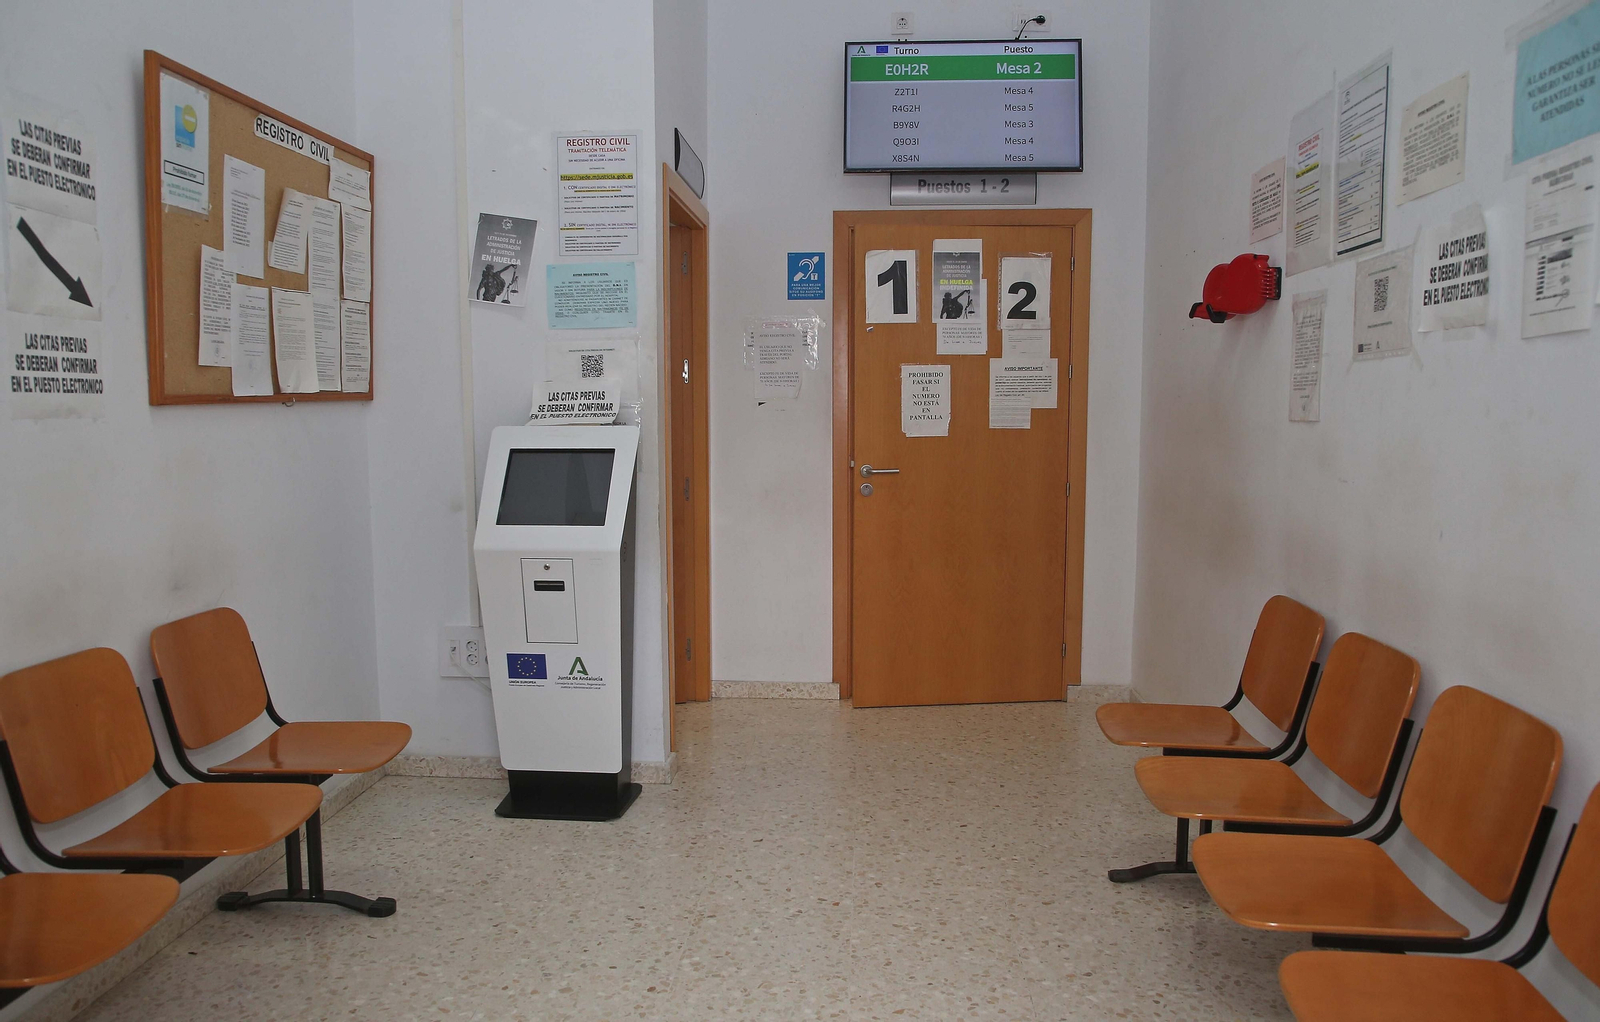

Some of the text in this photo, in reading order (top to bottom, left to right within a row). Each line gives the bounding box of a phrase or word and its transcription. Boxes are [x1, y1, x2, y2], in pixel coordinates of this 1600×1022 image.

[894, 45, 1034, 55] Turno Puesto
[885, 62, 1042, 76] E0H2R Mesa 2
[1004, 87, 1026, 95] Mesa
[892, 104, 1034, 113] R4G2H Mesa 5
[894, 120, 1034, 129] B9Y8V Mesa 3
[19, 119, 82, 156] LAS CITAS PREVIAS
[256, 118, 330, 162] REGISTRO CIVIL
[566, 138, 607, 147] REGISTRO
[1004, 137, 1026, 145] Mesa
[11, 138, 90, 179] SE DEBERAN CONFIRMAR
[892, 154, 920, 162] X8S4N
[1004, 154, 1026, 162] Mesa
[7, 158, 96, 200] EN EL PUESTO ELECTRONICO
[918, 178, 970, 194] Puestos
[980, 178, 988, 193] 1
[1000, 178, 1010, 193] 2
[1439, 242, 1449, 260] LAS
[1450, 238, 1465, 257] CITAS
[493, 256, 521, 265] HUELGA
[1430, 267, 1437, 284] SE
[1438, 261, 1462, 282] DEBERAN
[878, 260, 908, 314] 1
[1424, 289, 1432, 306] EN
[1434, 288, 1440, 304] EL
[1441, 284, 1459, 303] PUESTO
[1006, 281, 1037, 320] 2
[25, 333, 87, 353] LAS CITAS PREVIAS
[15, 354, 98, 374] SE DEBERAN CONFIRMAR
[11, 376, 103, 394] EN EL PUESTO ELECTRONICO
[548, 391, 606, 401] LAS CITAS PREVIAS
[547, 404, 575, 412] DEBERAN
[578, 403, 614, 411] CONFIRMAR
